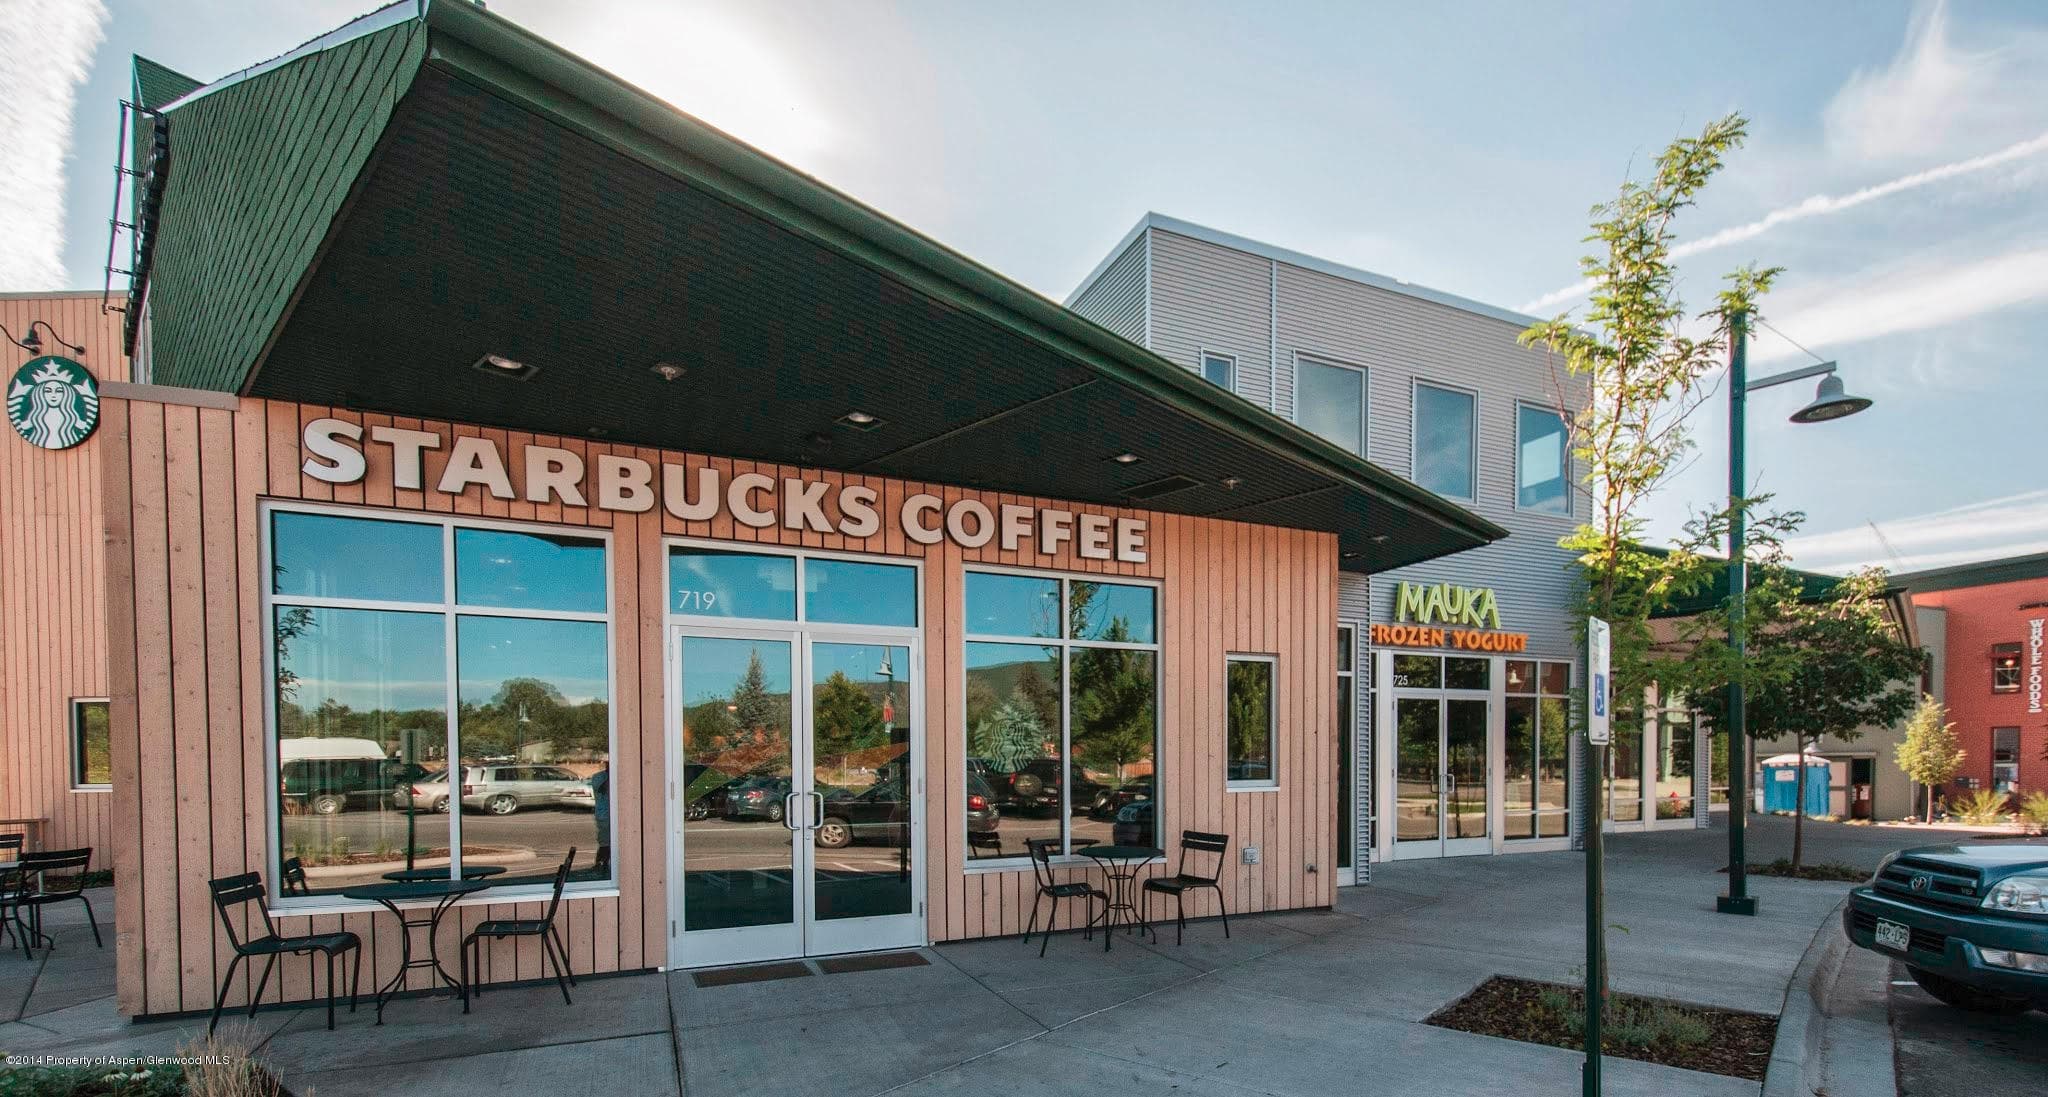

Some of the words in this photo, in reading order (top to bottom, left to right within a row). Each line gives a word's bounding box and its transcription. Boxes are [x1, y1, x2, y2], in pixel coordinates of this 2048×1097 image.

[301, 416, 881, 539] STARBUCKS
[900, 492, 1148, 564] COFFEE
[678, 590, 715, 610] 719
[1395, 580, 1501, 629] MAUKA
[1370, 623, 1446, 648] FROZEN
[1452, 629, 1529, 652] YOGURT
[2029, 618, 2045, 665] WHOLE
[1393, 674, 1409, 686] 725
[2029, 666, 2042, 709] FOODS
